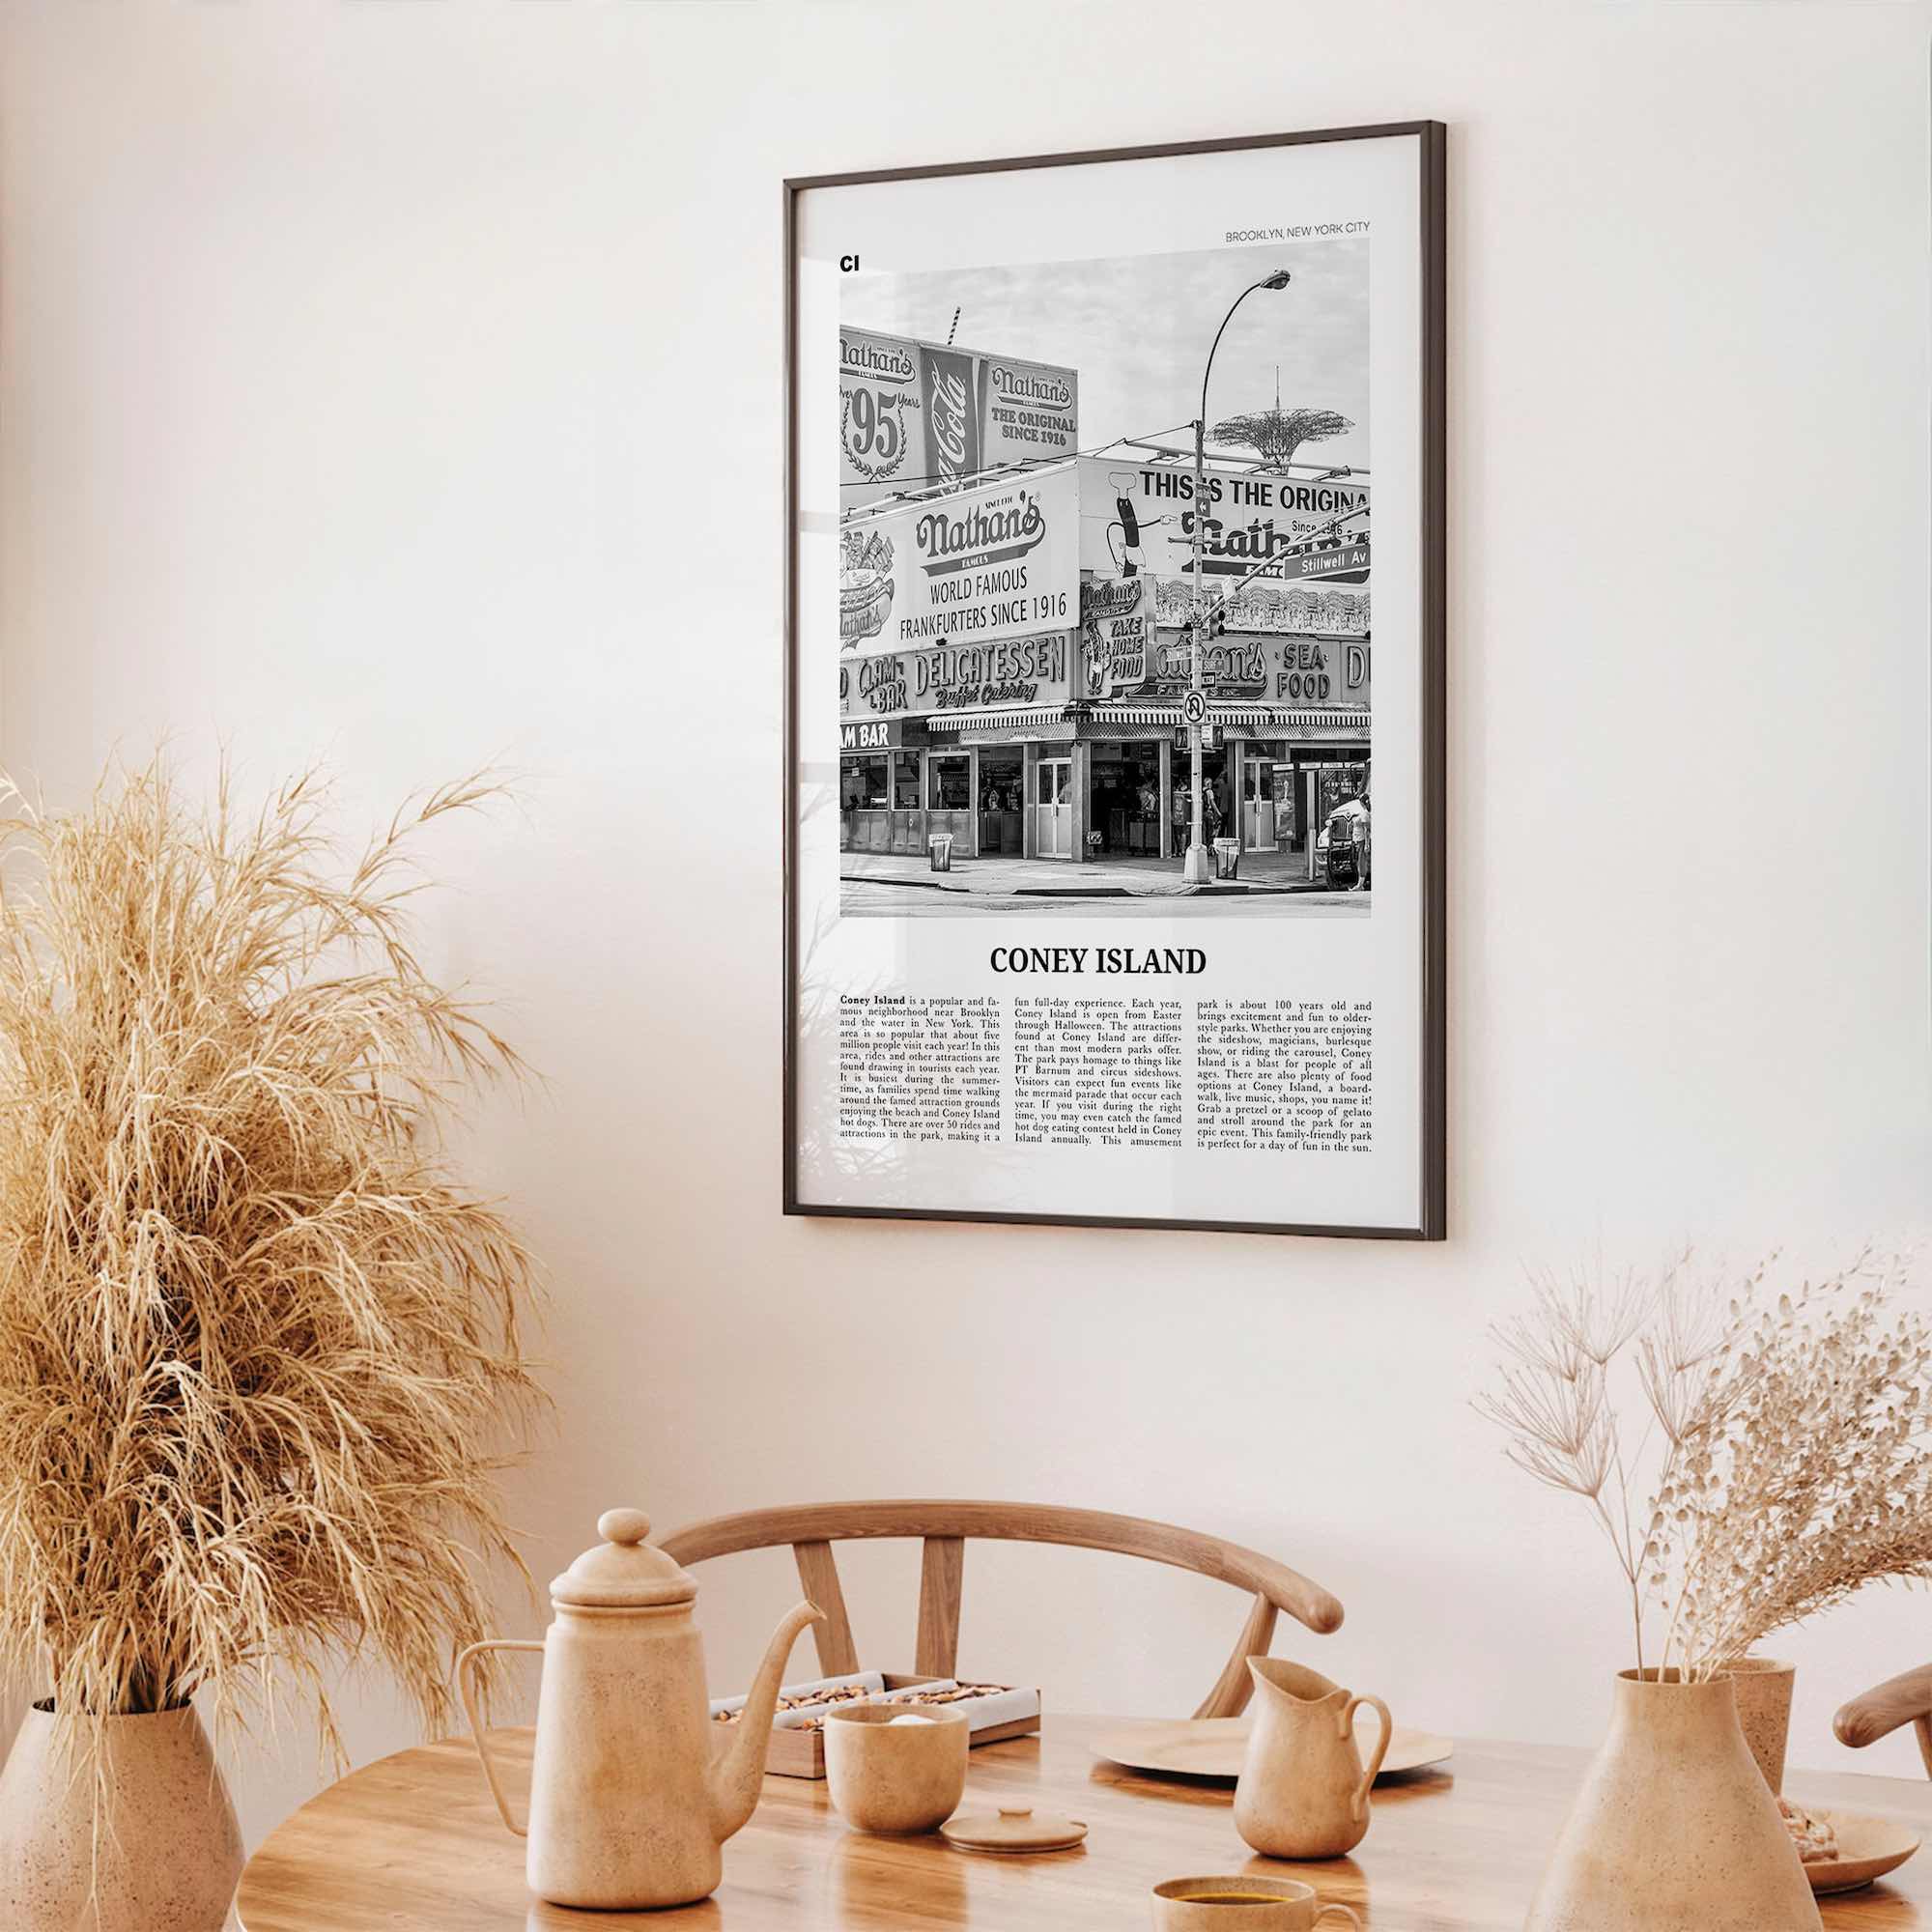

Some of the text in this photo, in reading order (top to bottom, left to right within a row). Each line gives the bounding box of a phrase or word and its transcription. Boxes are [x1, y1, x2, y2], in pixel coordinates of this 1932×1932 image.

[1226, 221, 1371, 242] BROOKLYN, NEW YORK CITY
[840, 255, 860, 272] CI
[991, 367, 1071, 403] Nathan's
[852, 387, 898, 458] 95
[991, 407, 1077, 434] THE ORIGINAL
[1002, 425, 1067, 447] SINCE 1916
[1139, 470, 1195, 500] THIS
[1229, 480, 1273, 507] THE
[917, 490, 1041, 557] Nathan's
[1292, 520, 1317, 532] Since
[1301, 551, 1366, 573] Stillwell Av
[930, 566, 1028, 606] WORLD FAMOUS
[900, 607, 986, 640] FRANKFURTERS
[991, 599, 1028, 627] SINCE
[1033, 592, 1067, 619] 1916
[1283, 642, 1324, 671] SEA
[915, 635, 1066, 696] DELICATESSEN
[1277, 673, 1330, 699] FOOD
[876, 679, 908, 714] BAR
[859, 723, 889, 748] BAR
[990, 947, 1207, 975] CONEY ISLAND
[839, 996, 869, 1007] Coney
[873, 996, 905, 1005] Island
[909, 996, 916, 1005] is
[929, 997, 963, 1008] popular
[967, 997, 983, 1006] and
[987, 997, 999, 1006] fa-
[1014, 998, 1181, 1010] fun full-day experience. Each year,
[1197, 1000, 1372, 1012] park is about 100 years old and
[839, 1017, 1000, 1029] and the water in New York. This
[1014, 1020, 1181, 1032] through Halloween. The attractions
[1197, 1023, 1217, 1034] style
[1220, 1023, 1248, 1035] parks.
[1251, 1023, 1292, 1033] Whether
[1293, 1027, 1310, 1036] you
[1330, 1025, 1372, 1037] enjoying
[839, 1062, 999, 1076] found drawing in tourists each year.
[1015, 1065, 1181, 1077] PT Barnum and circus sideshows.
[1197, 1071, 1219, 1080] ages.
[1224, 1069, 1252, 1079] There
[1277, 1070, 1295, 1080] also
[1300, 1071, 1329, 1083] plenty
[1334, 1071, 1345, 1081] of
[1350, 1072, 1372, 1081] food
[839, 1095, 1000, 1110] around the famed attraction grounds
[1014, 1100, 1181, 1114] year. If you visit during the right
[1197, 1103, 1221, 1113] Grab
[1235, 1104, 1267, 1117] pretzel
[1296, 1108, 1323, 1118] scoop
[1327, 1107, 1338, 1116] of
[1343, 1107, 1372, 1119] gelato
[839, 1128, 885, 1138] attractions
[890, 1129, 898, 1138] in
[902, 1130, 916, 1139] the
[921, 1130, 943, 1142] park,
[947, 1131, 980, 1143] making
[983, 1132, 989, 1141] it
[1015, 1133, 1181, 1147] Island annually. This amusement
[1197, 1138, 1205, 1148] is
[1208, 1139, 1239, 1151] perfect
[1243, 1140, 1256, 1149] for
[1267, 1140, 1285, 1151] day
[1288, 1141, 1298, 1150] of
[1302, 1141, 1318, 1151] fun
[1321, 1142, 1330, 1151] in
[1333, 1142, 1349, 1151] the
